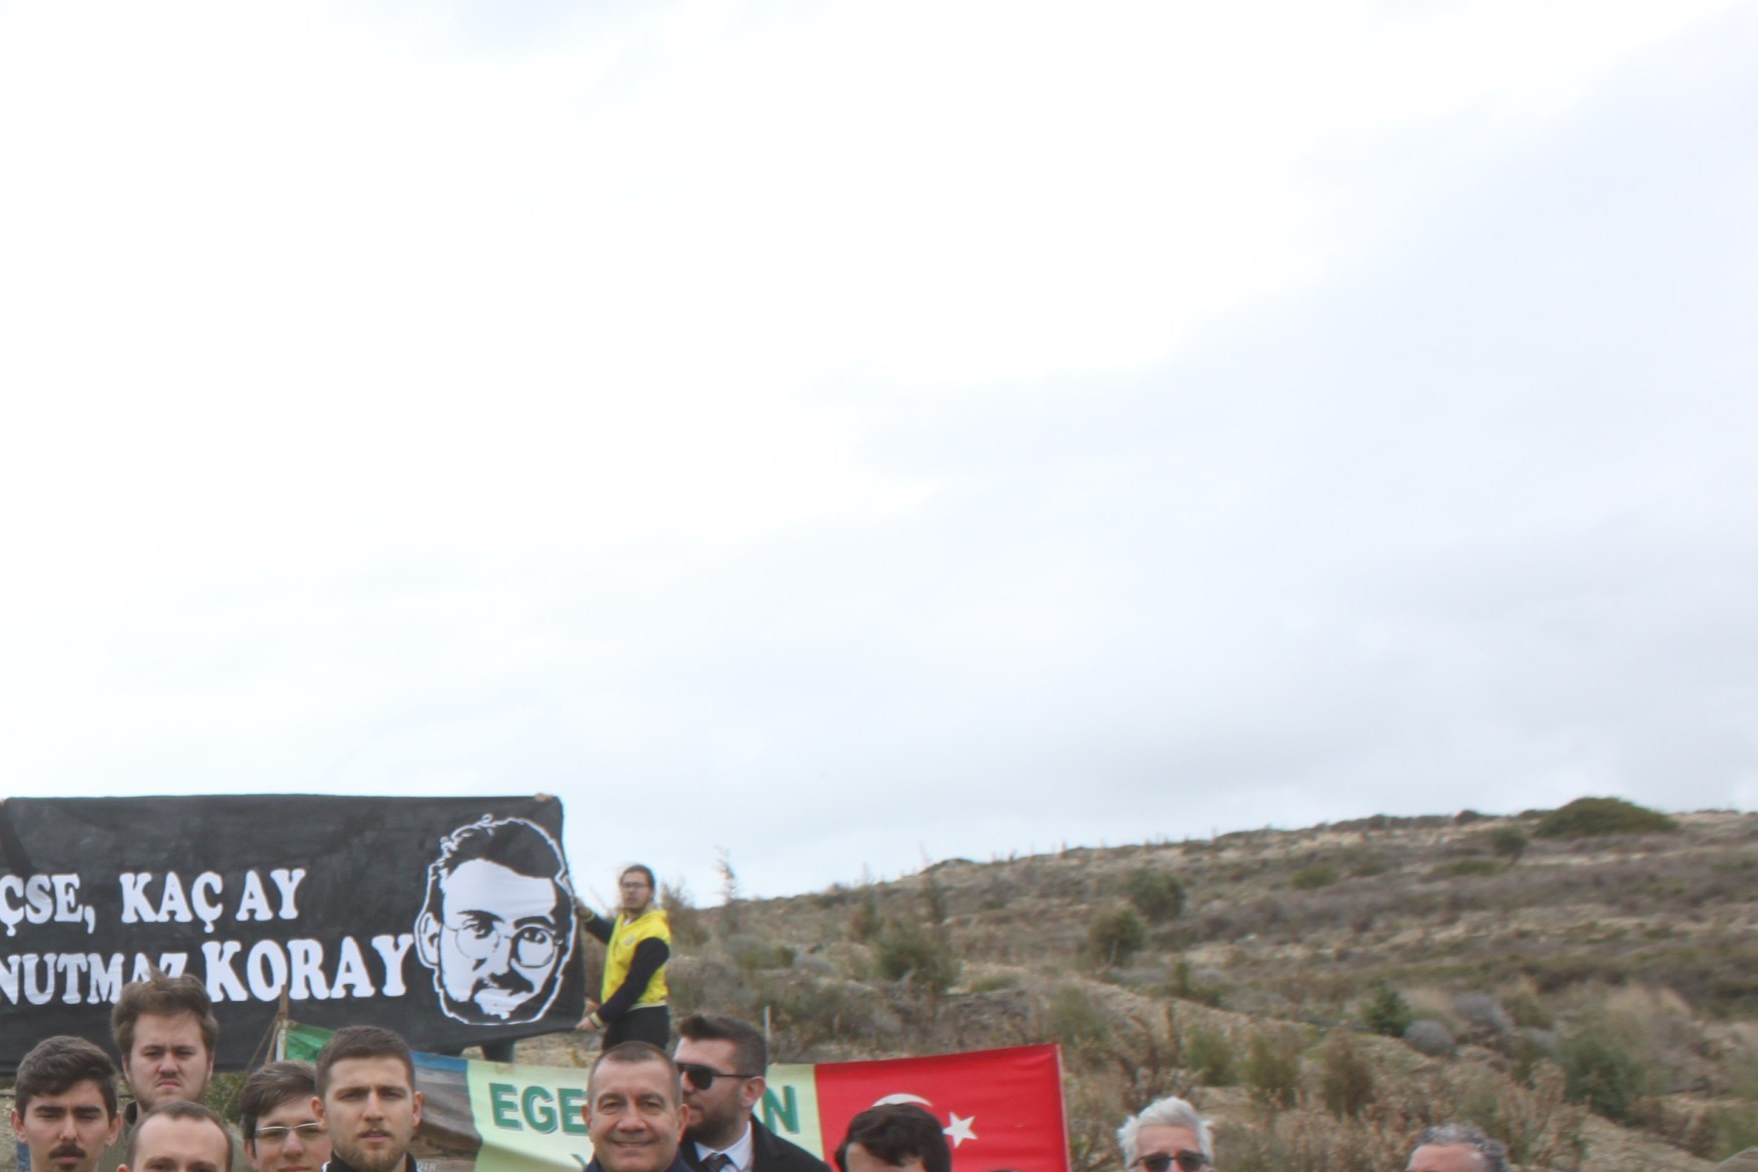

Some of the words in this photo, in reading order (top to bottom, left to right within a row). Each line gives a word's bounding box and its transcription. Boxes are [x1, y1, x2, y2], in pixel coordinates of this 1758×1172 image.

[119, 871, 224, 933] KAÇ
[235, 868, 307, 922] AY
[201, 933, 412, 1003] KORAY
